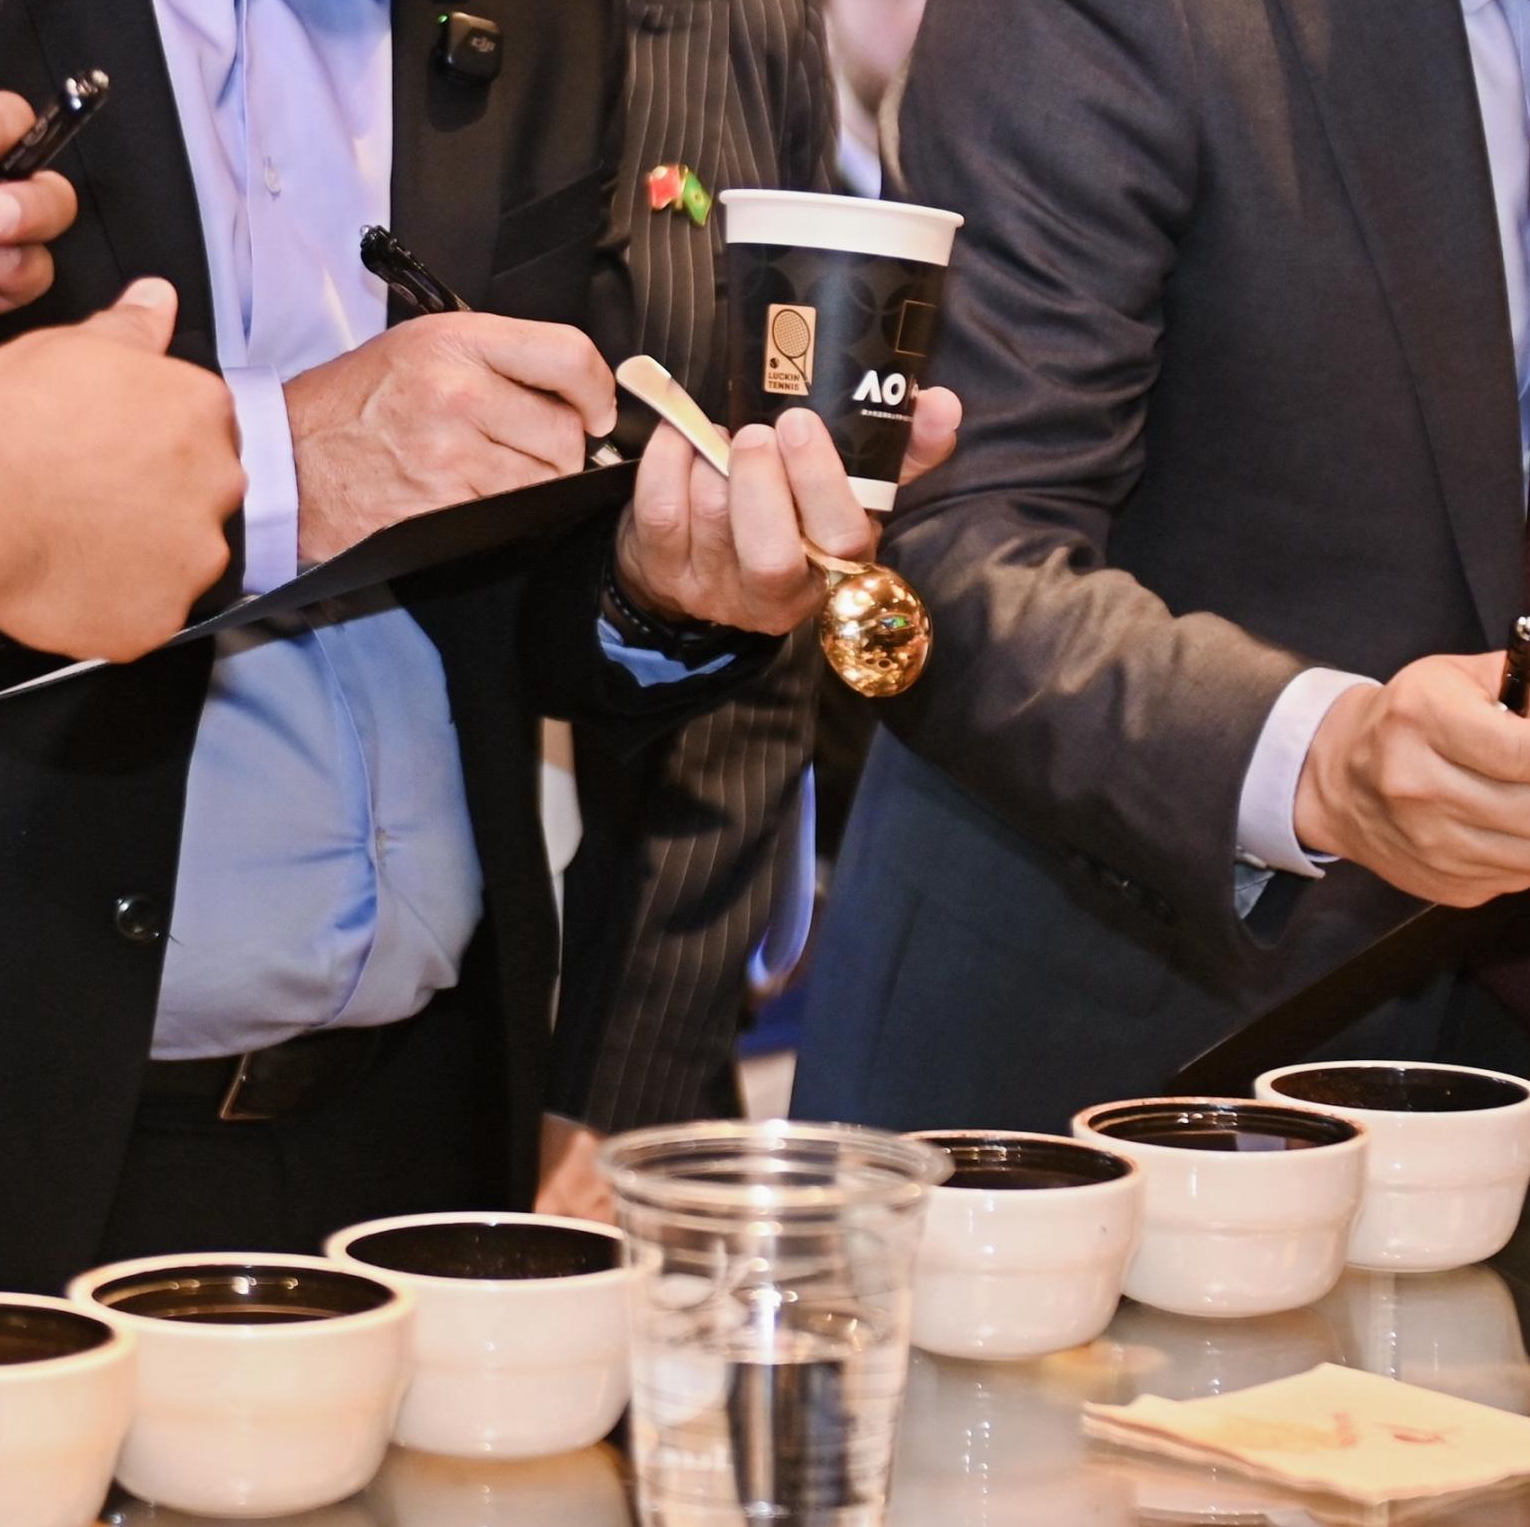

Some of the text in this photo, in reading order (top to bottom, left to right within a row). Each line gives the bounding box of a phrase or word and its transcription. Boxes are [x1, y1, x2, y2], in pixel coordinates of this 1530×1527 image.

[768, 372, 800, 381] LUCKIN
[768, 380, 799, 390] TENNIS
[852, 369, 907, 406] AO
